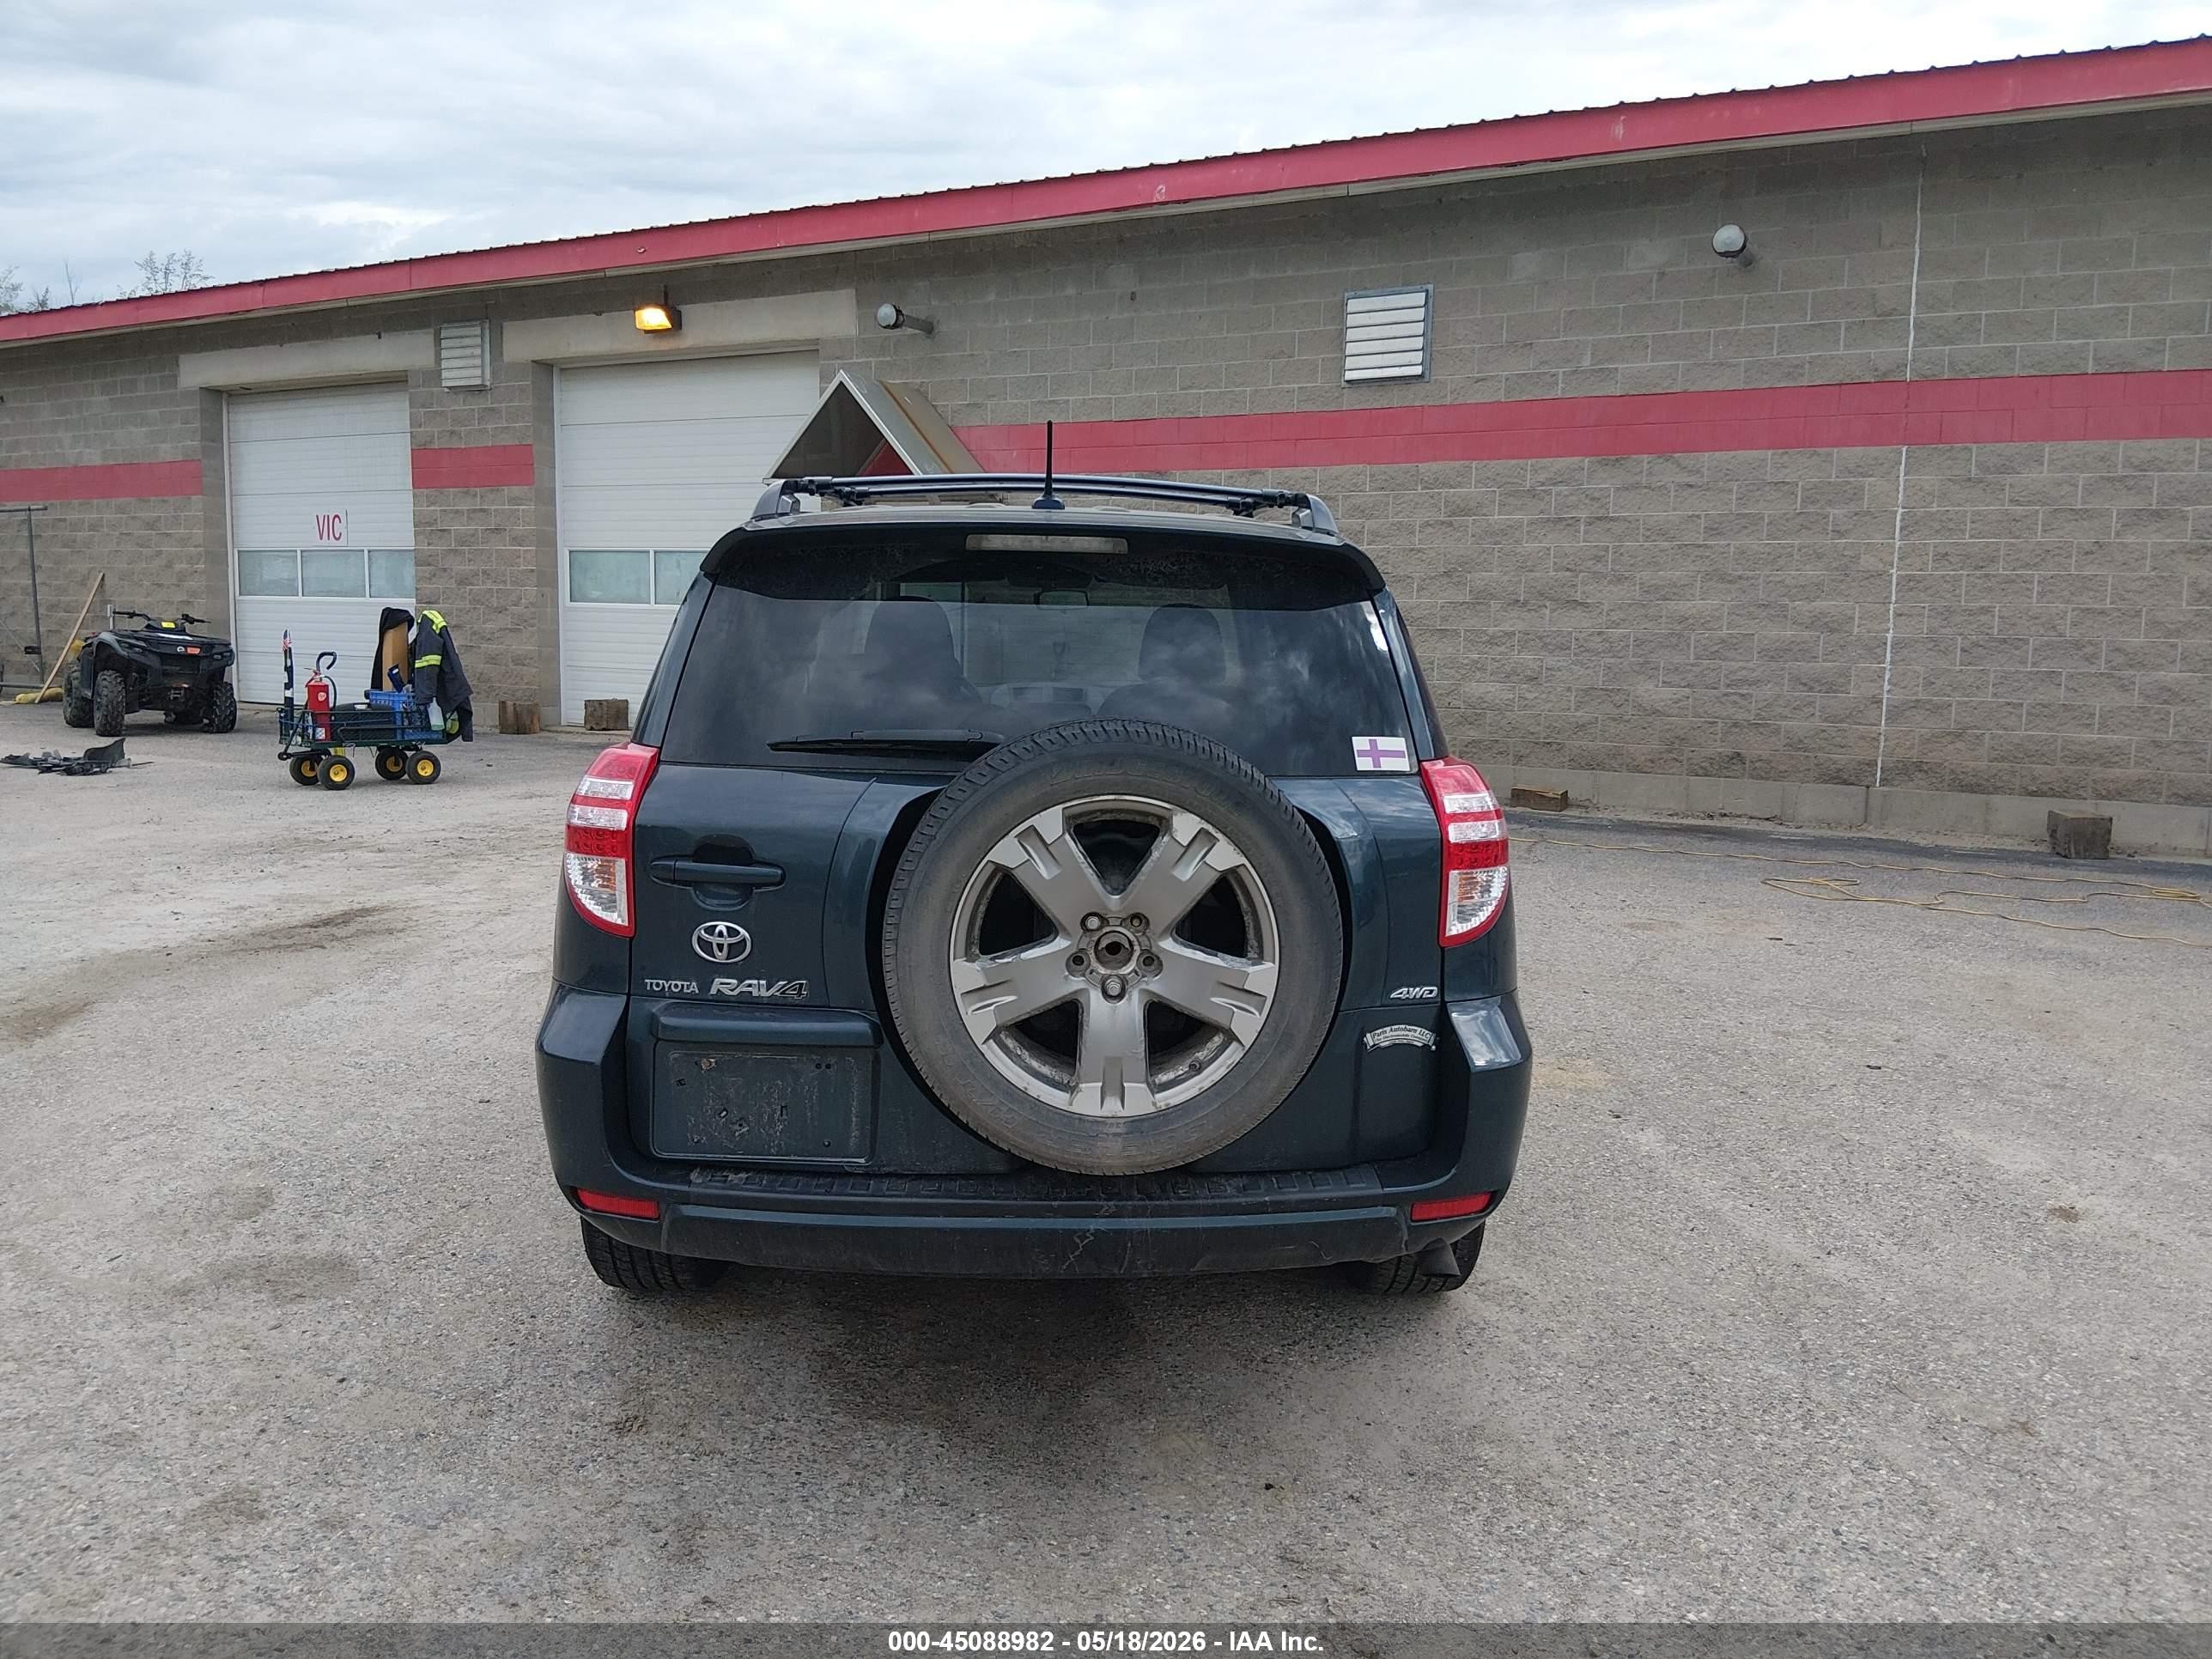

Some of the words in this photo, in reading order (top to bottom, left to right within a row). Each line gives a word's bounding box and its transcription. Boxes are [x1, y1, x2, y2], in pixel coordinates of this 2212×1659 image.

[316, 514, 343, 541] VIC
[645, 979, 700, 994] TOYOTA
[710, 978, 808, 999] RAV4
[1389, 987, 1438, 999] 4WD
